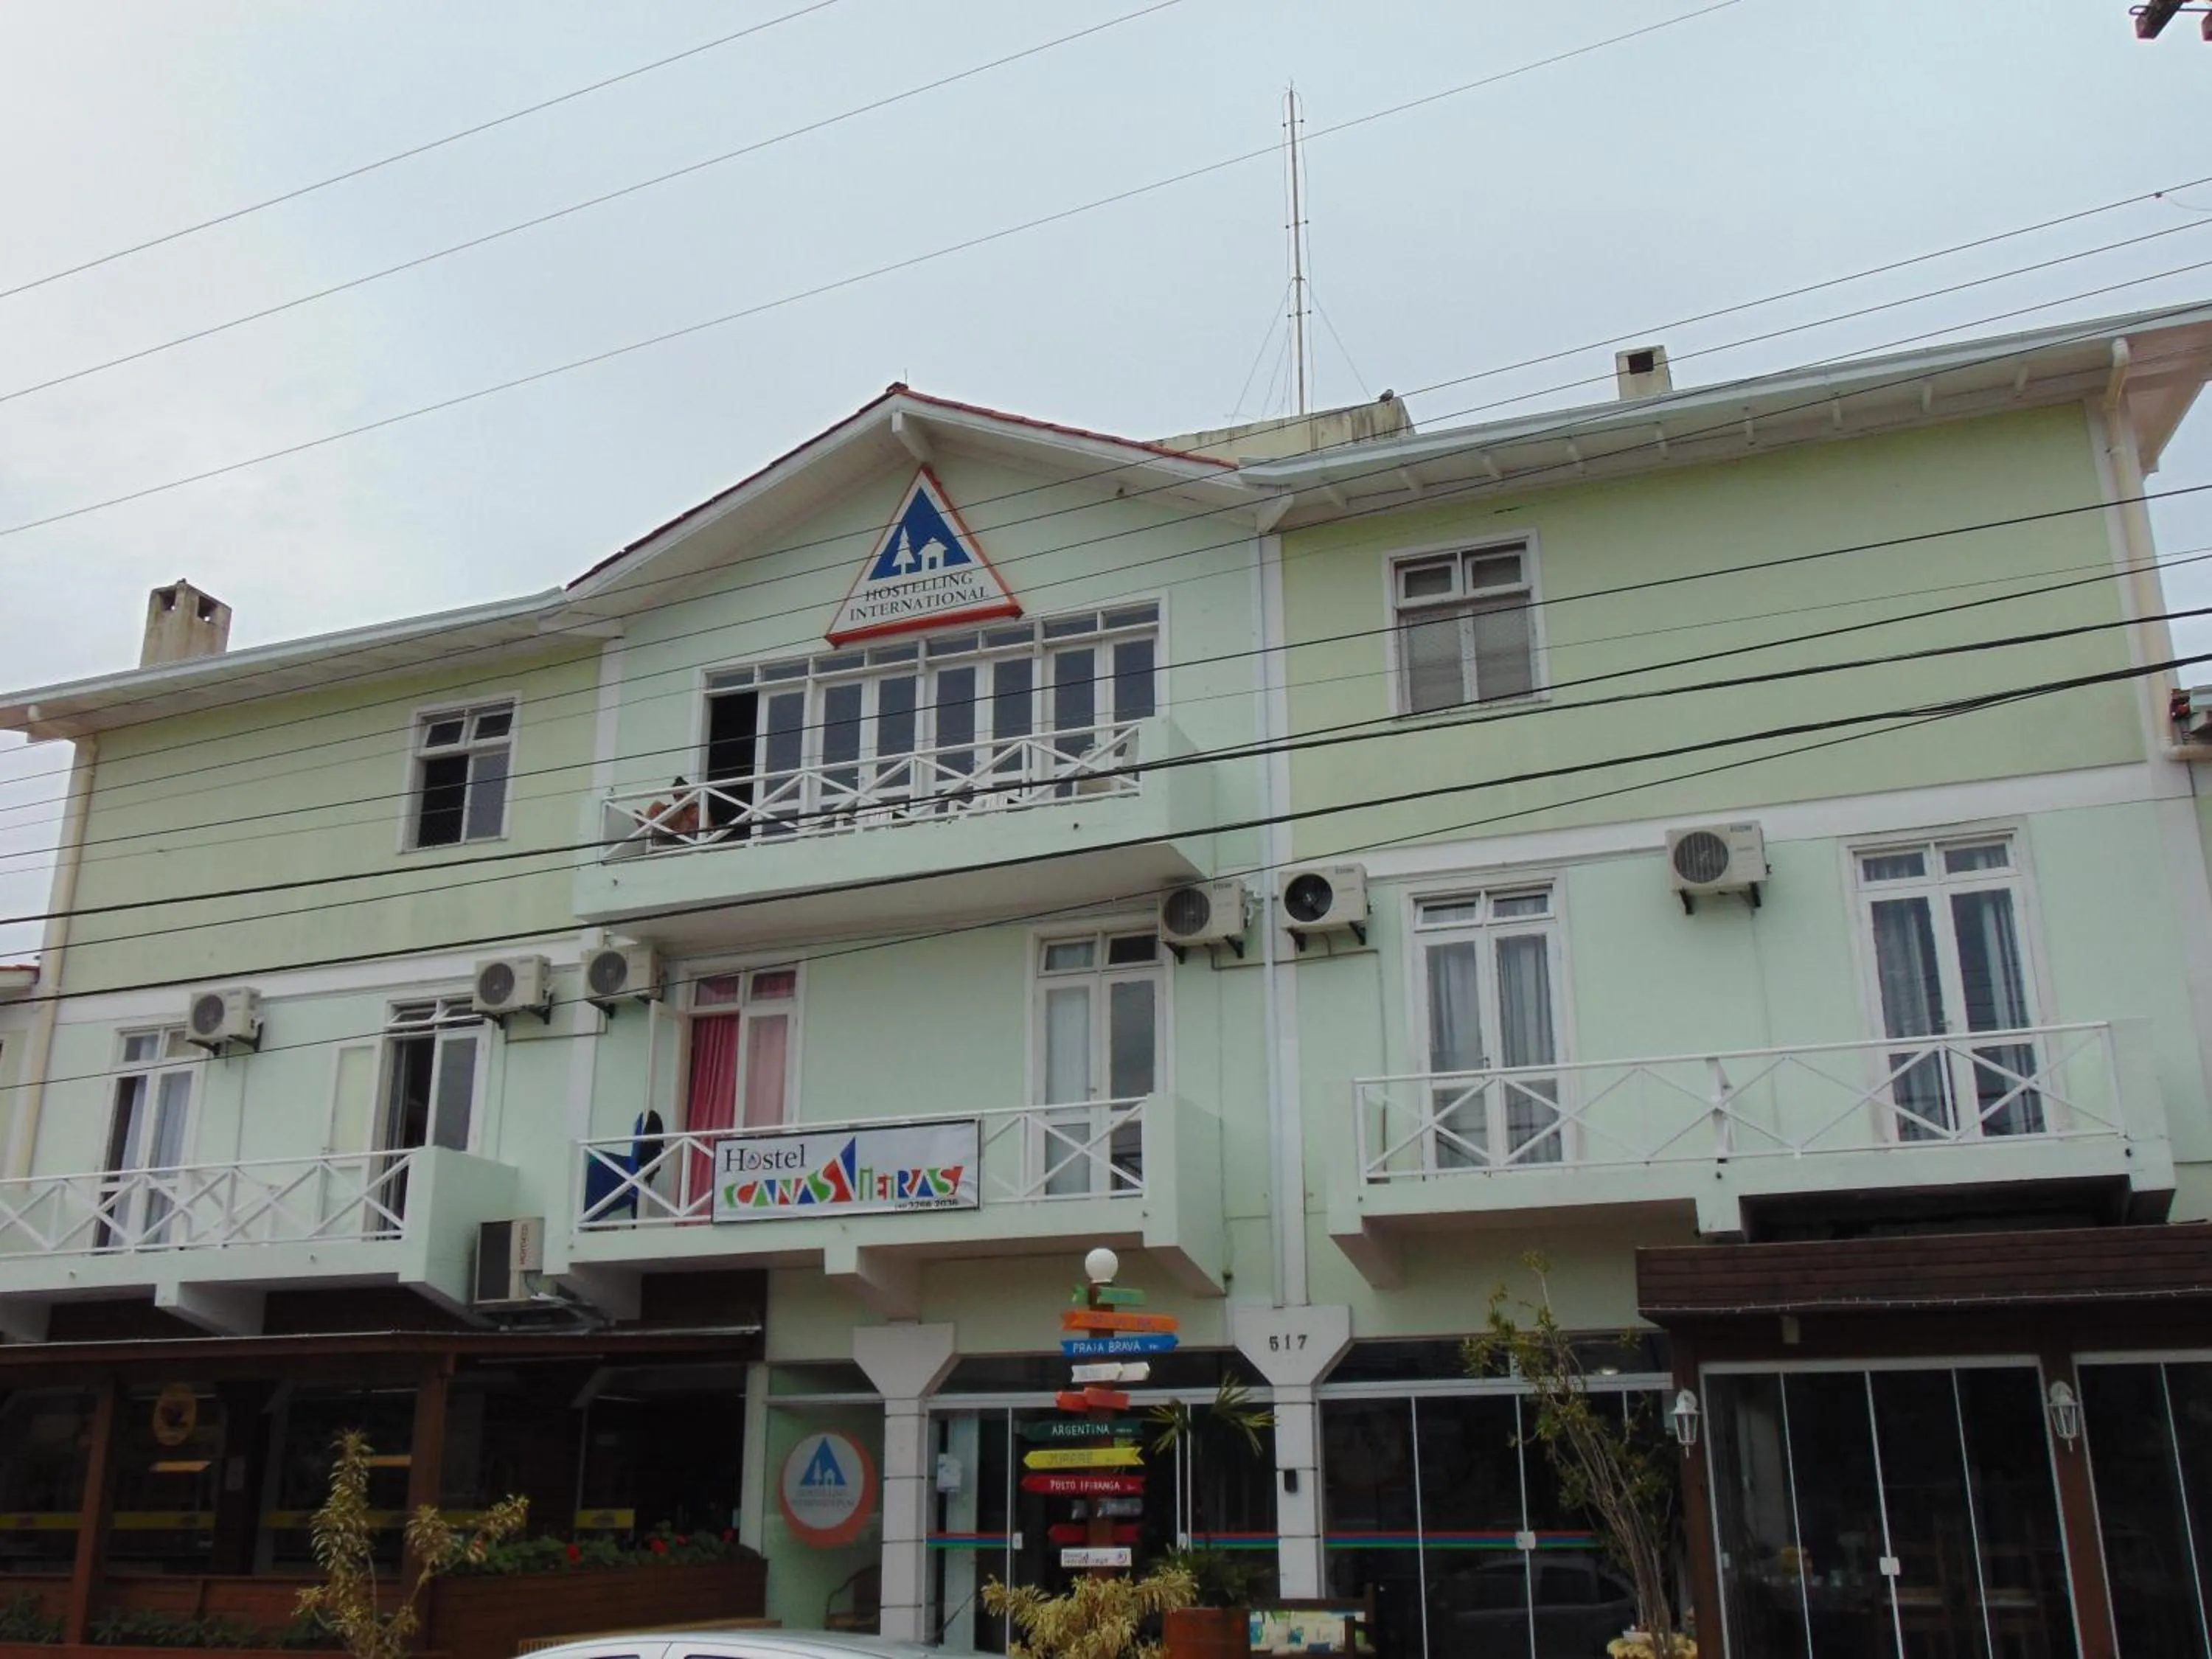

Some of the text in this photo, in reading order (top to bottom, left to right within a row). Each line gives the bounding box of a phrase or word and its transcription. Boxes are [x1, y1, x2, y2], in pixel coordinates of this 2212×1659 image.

[866, 572, 973, 602] HOSTELLING
[850, 587, 989, 621] INTERNATIONAL
[724, 1144, 806, 1172] Hostel
[1073, 1343, 1104, 1354] PRAIA
[1108, 1340, 1141, 1353] BRAVA
[1270, 1334, 1308, 1352] 517
[1051, 1424, 1110, 1436] ARGENTINA
[1049, 1480, 1076, 1490] POSTO
